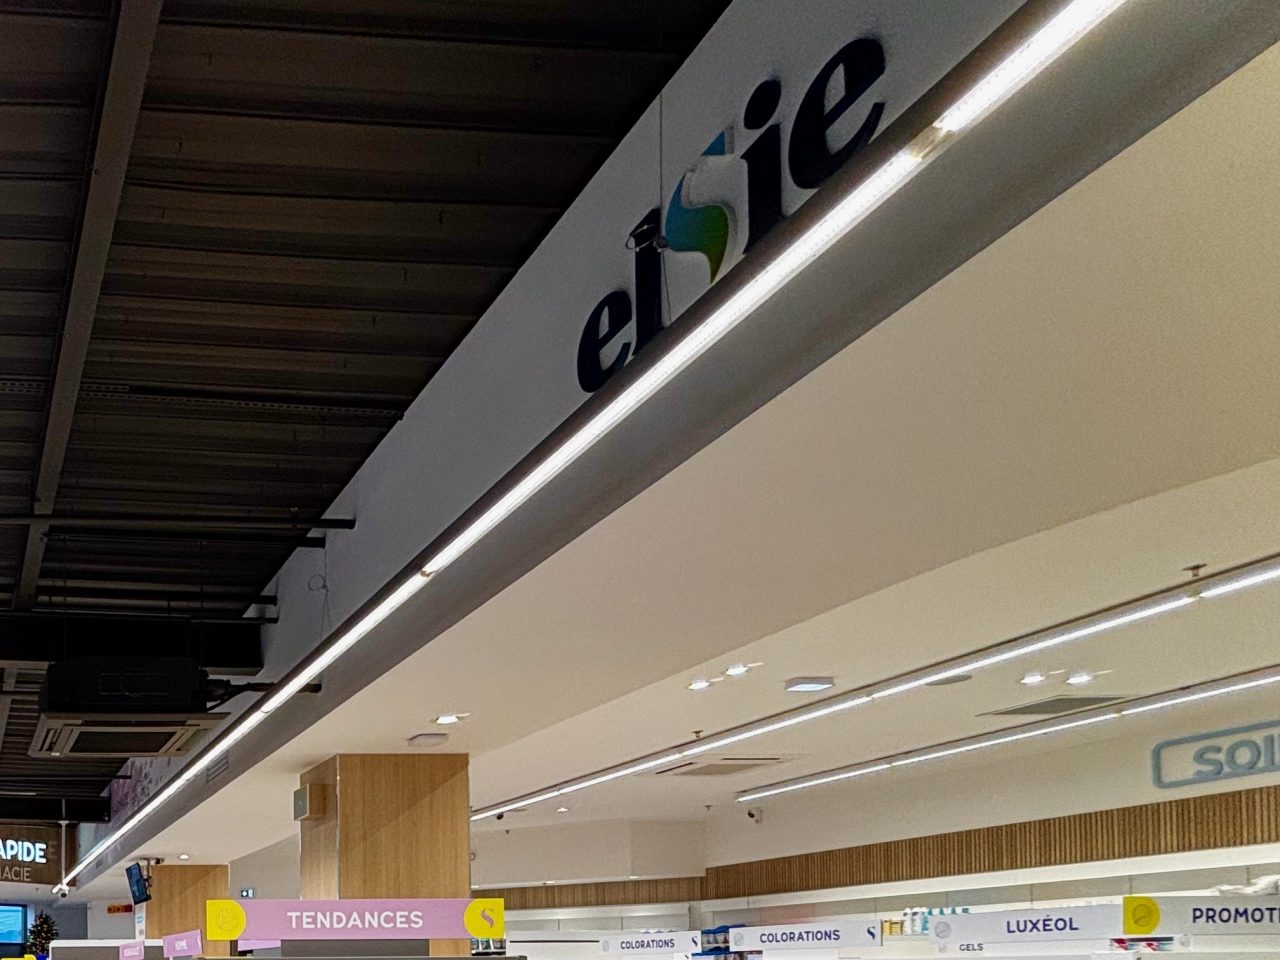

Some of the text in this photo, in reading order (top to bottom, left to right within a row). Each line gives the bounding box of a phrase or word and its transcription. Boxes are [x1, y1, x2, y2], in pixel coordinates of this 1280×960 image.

[1193, 734, 1280, 776] SOI
[287, 911, 423, 929] TENDANCES
[1006, 915, 1079, 934] LUXÉOL
[620, 938, 675, 950] COLORATIONS
[759, 929, 841, 944] COLORATIONS
[959, 943, 983, 952] GELS
